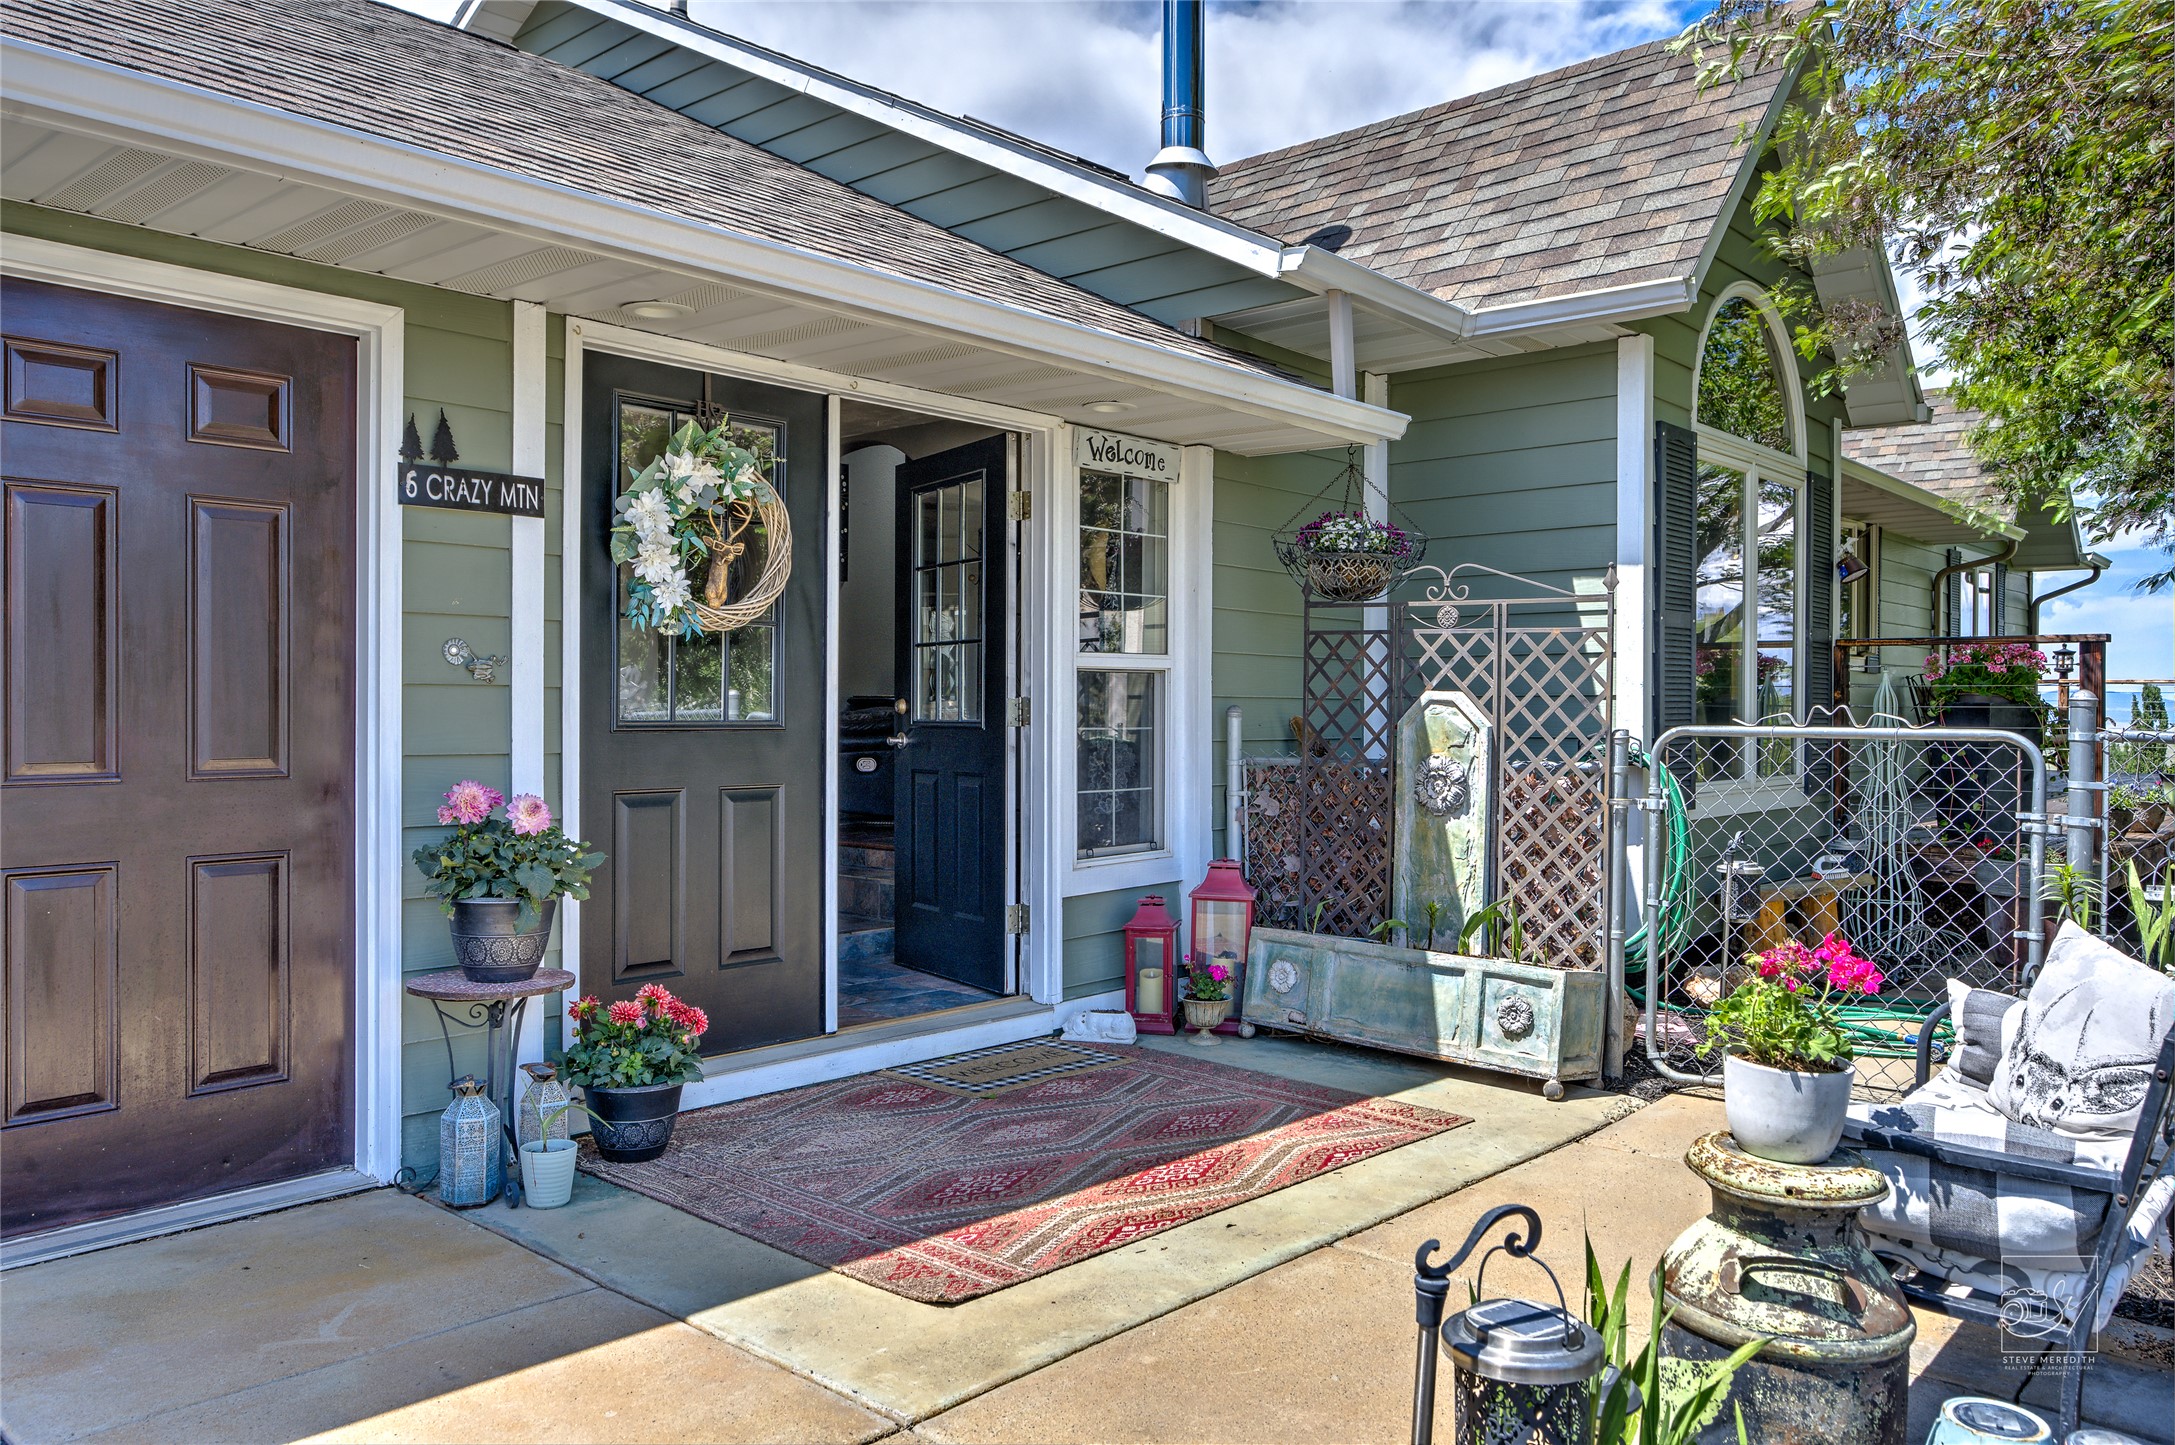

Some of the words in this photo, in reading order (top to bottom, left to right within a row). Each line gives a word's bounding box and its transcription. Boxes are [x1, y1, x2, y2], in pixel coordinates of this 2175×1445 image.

[405, 469, 418, 498] 6
[426, 473, 493, 505] CRAZY
[500, 481, 539, 510] MTN
[949, 1049, 1068, 1077] WELCOME
